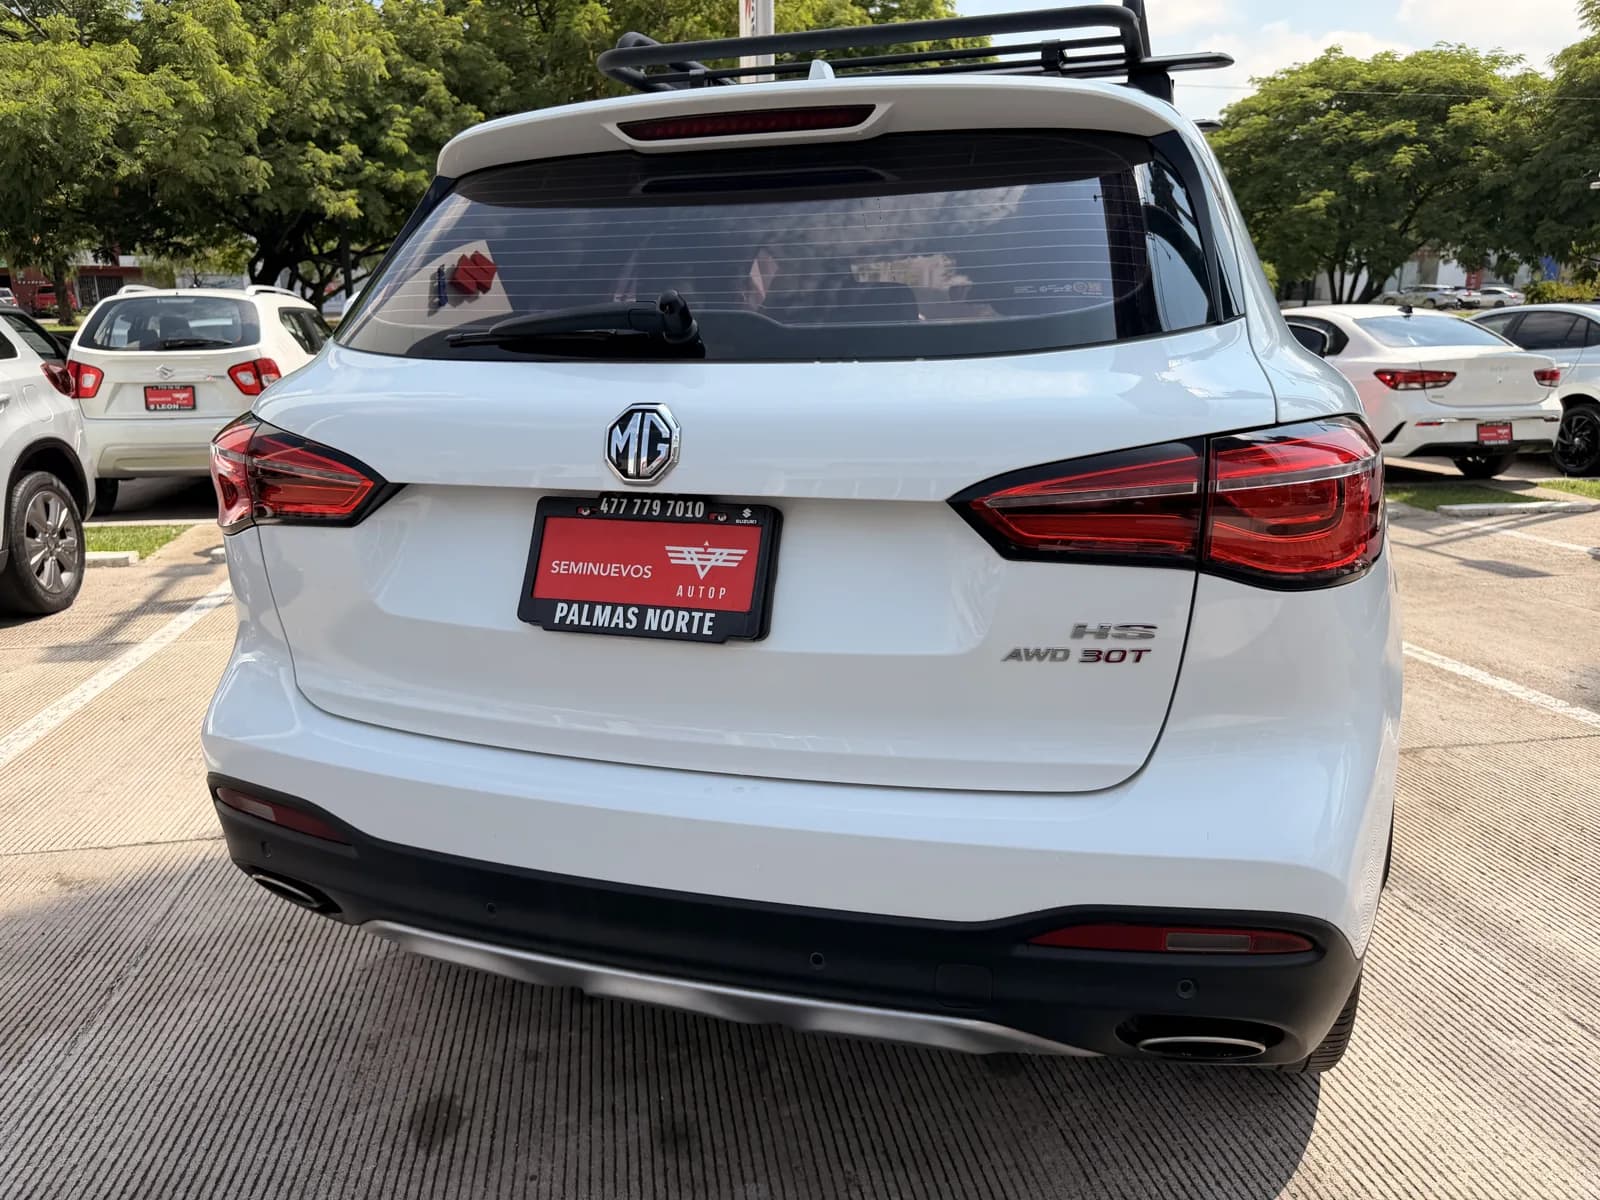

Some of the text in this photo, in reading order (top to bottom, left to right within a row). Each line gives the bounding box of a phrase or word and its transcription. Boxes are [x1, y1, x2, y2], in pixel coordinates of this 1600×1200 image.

[609, 411, 671, 477] MG
[599, 498, 705, 518] 477 779 7010
[551, 560, 652, 579] SEMINUEVOS
[676, 584, 727, 600] AUTOP
[554, 602, 715, 636] PALMAS NORTE
[1070, 623, 1158, 640] HS
[1001, 648, 1152, 664] AWD 30T
